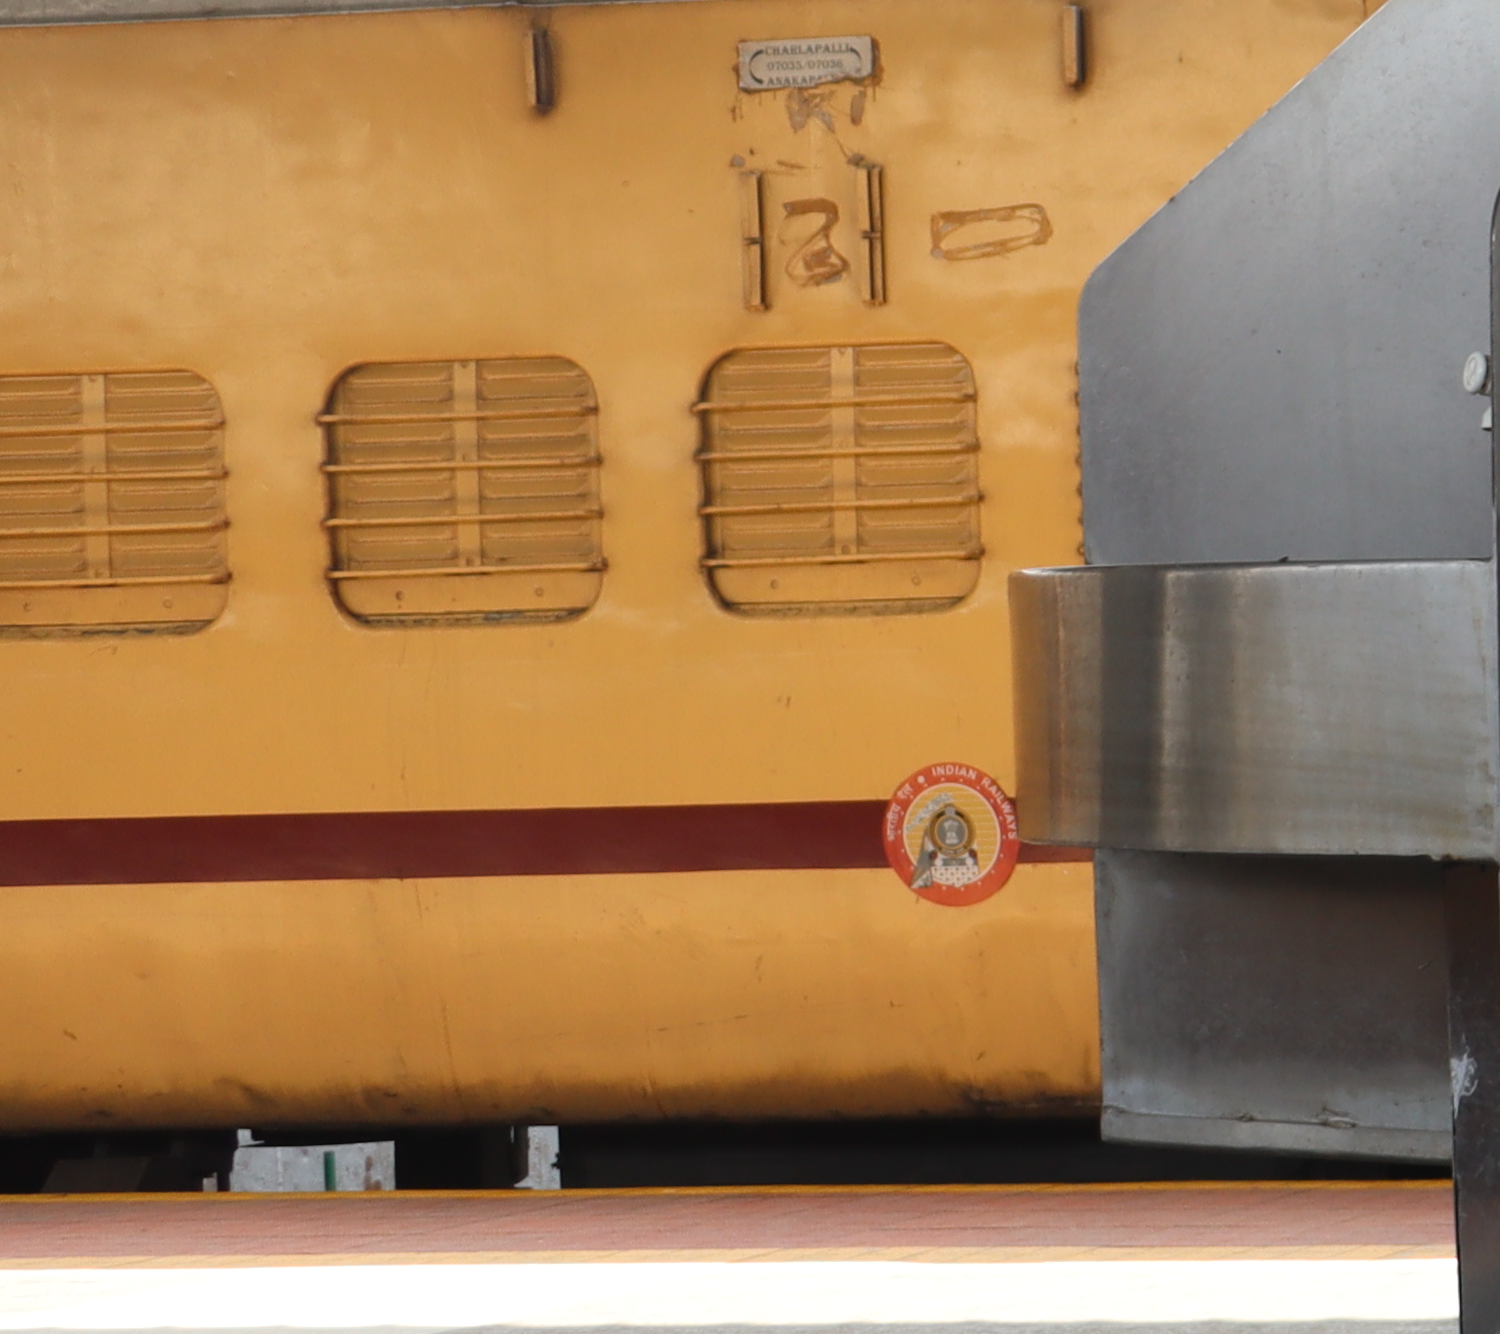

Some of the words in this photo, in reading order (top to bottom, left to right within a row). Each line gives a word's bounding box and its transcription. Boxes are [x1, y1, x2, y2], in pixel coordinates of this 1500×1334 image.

[764, 43, 849, 56] CHARLAPALLI
[931, 764, 978, 780] INDIAN
[980, 776, 1018, 840] RAILWAYS
